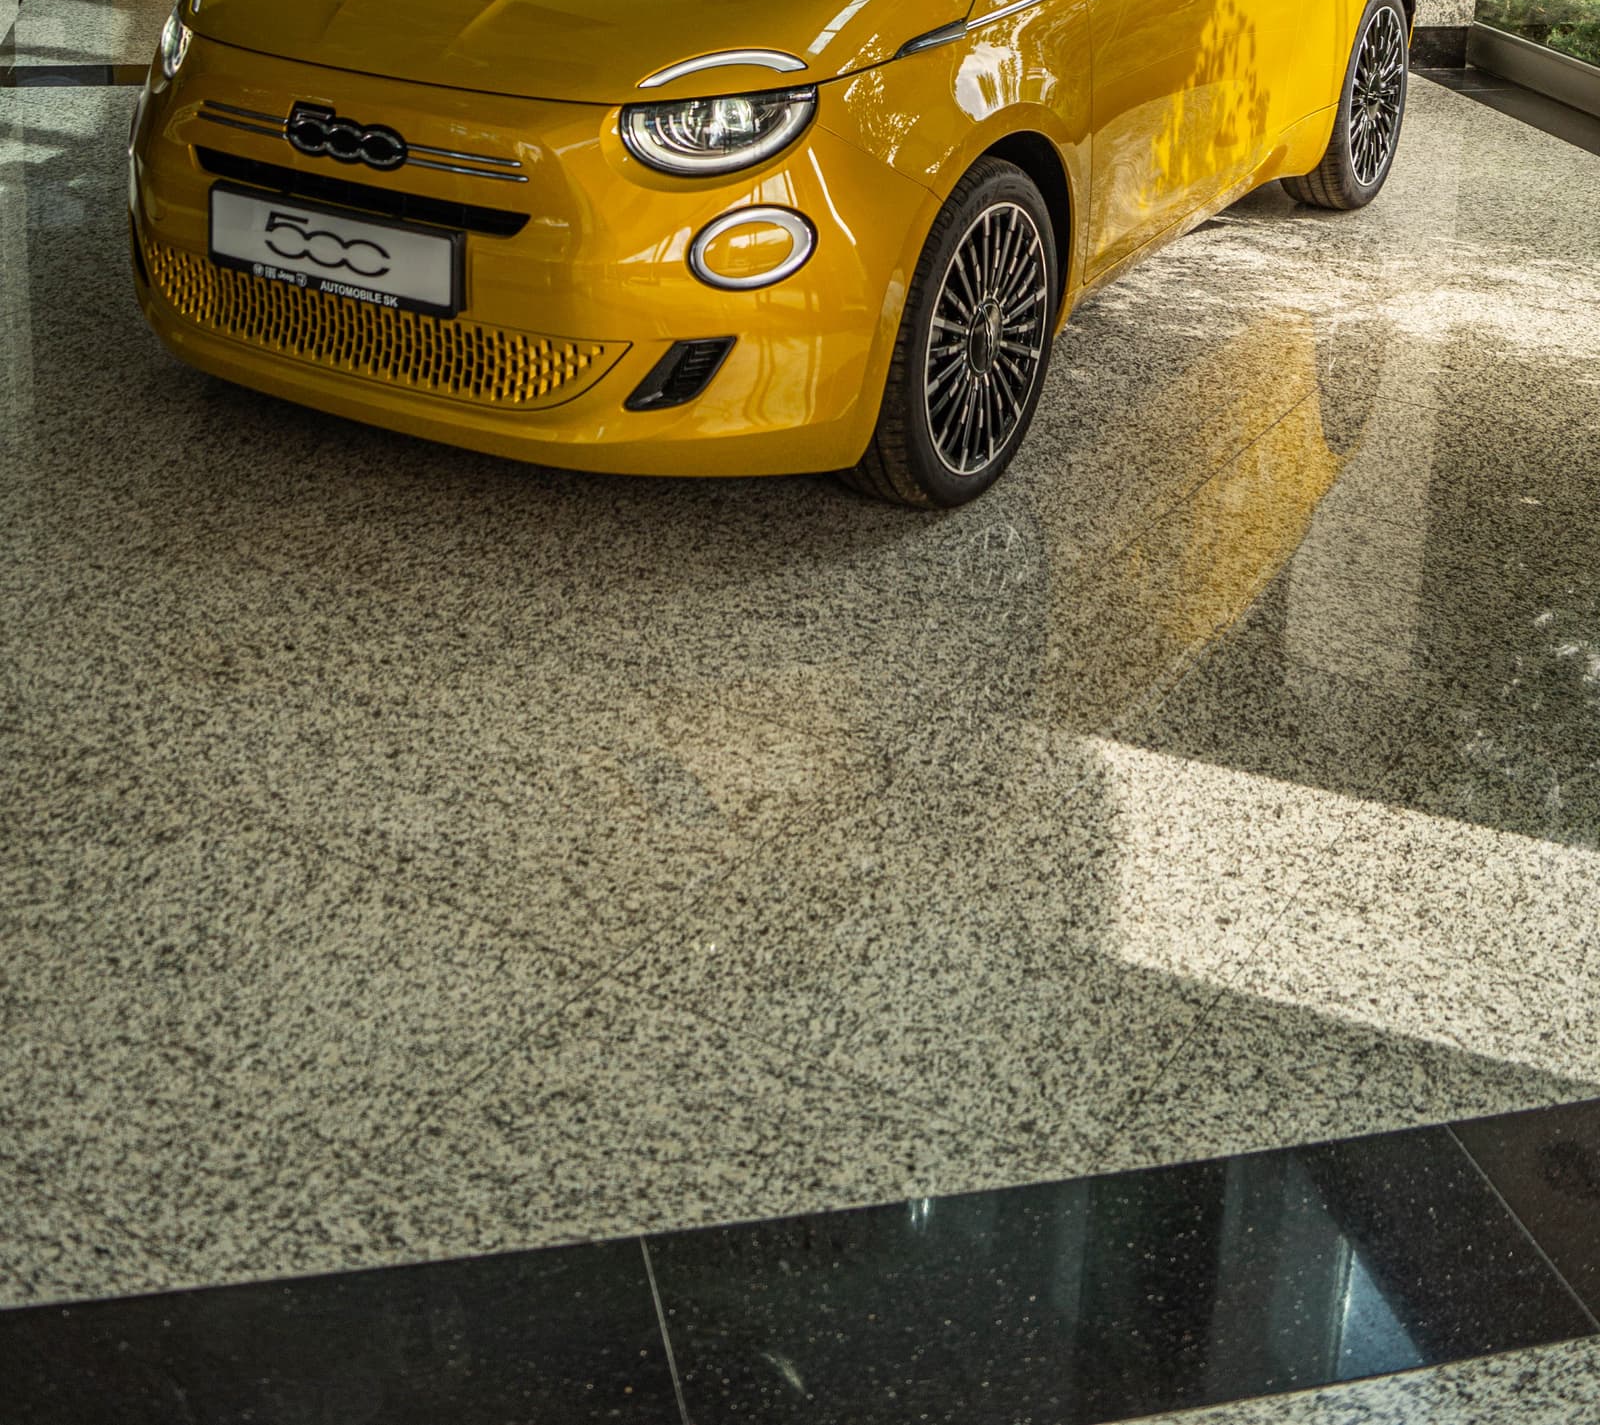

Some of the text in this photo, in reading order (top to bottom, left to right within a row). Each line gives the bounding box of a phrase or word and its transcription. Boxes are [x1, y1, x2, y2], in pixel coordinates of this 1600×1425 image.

[289, 103, 406, 169] 500
[265, 210, 390, 277] 500
[320, 279, 383, 304] AUTOMOBILE
[383, 294, 399, 308] SK
